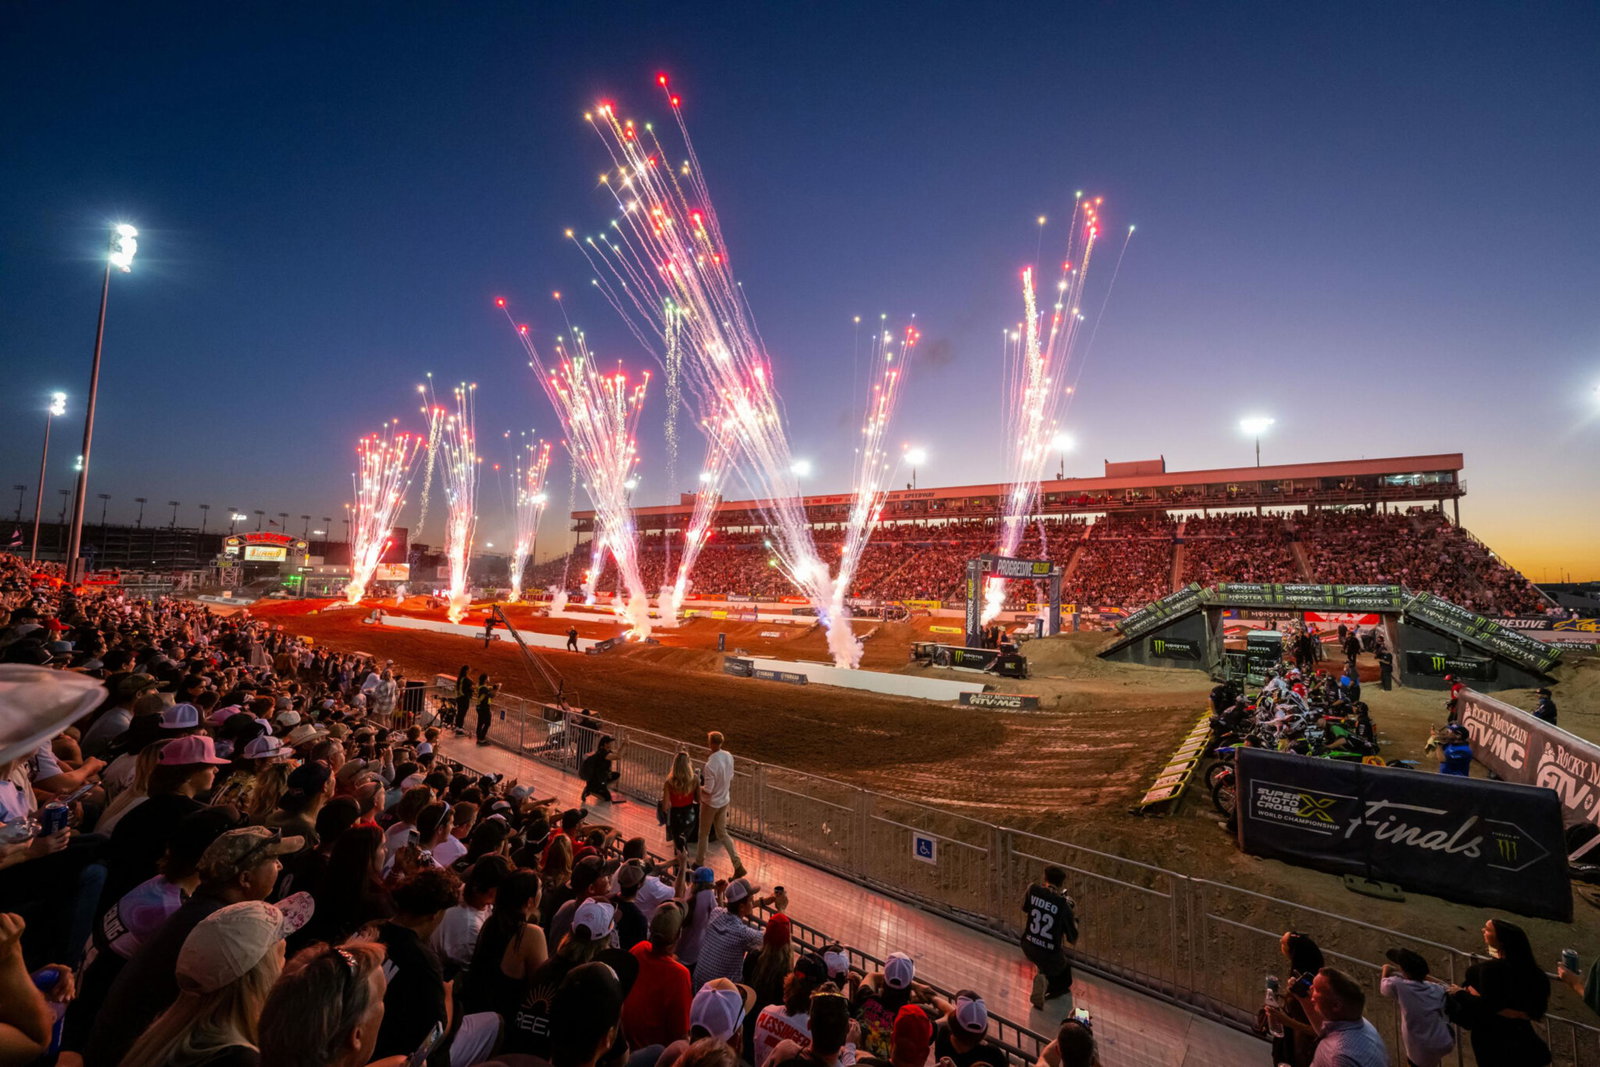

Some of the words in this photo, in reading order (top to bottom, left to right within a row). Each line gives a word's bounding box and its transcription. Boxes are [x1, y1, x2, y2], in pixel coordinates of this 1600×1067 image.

[1422, 607, 1462, 629] MONSTER
[1431, 598, 1474, 621] MONSTER
[1491, 637, 1536, 661] MONSTER
[1500, 628, 1546, 651] MONSTER
[1446, 660, 1478, 668] MONSTER
[1472, 702, 1493, 724] ROCKY
[1491, 711, 1530, 745] MOUNTAIN
[1555, 744, 1589, 779] ROCKY
[1257, 787, 1301, 802] SUPER
[1259, 794, 1300, 807] MOTO
[1256, 800, 1301, 814] CROSS
[1258, 810, 1283, 819] WORLD
[1284, 815, 1341, 831] CHAMPIONSHIP
[1344, 799, 1484, 859] Finals
[1030, 895, 1058, 915] VIDEO
[1029, 908, 1054, 940] 32
[757, 1013, 812, 1048] PLESSINGER
